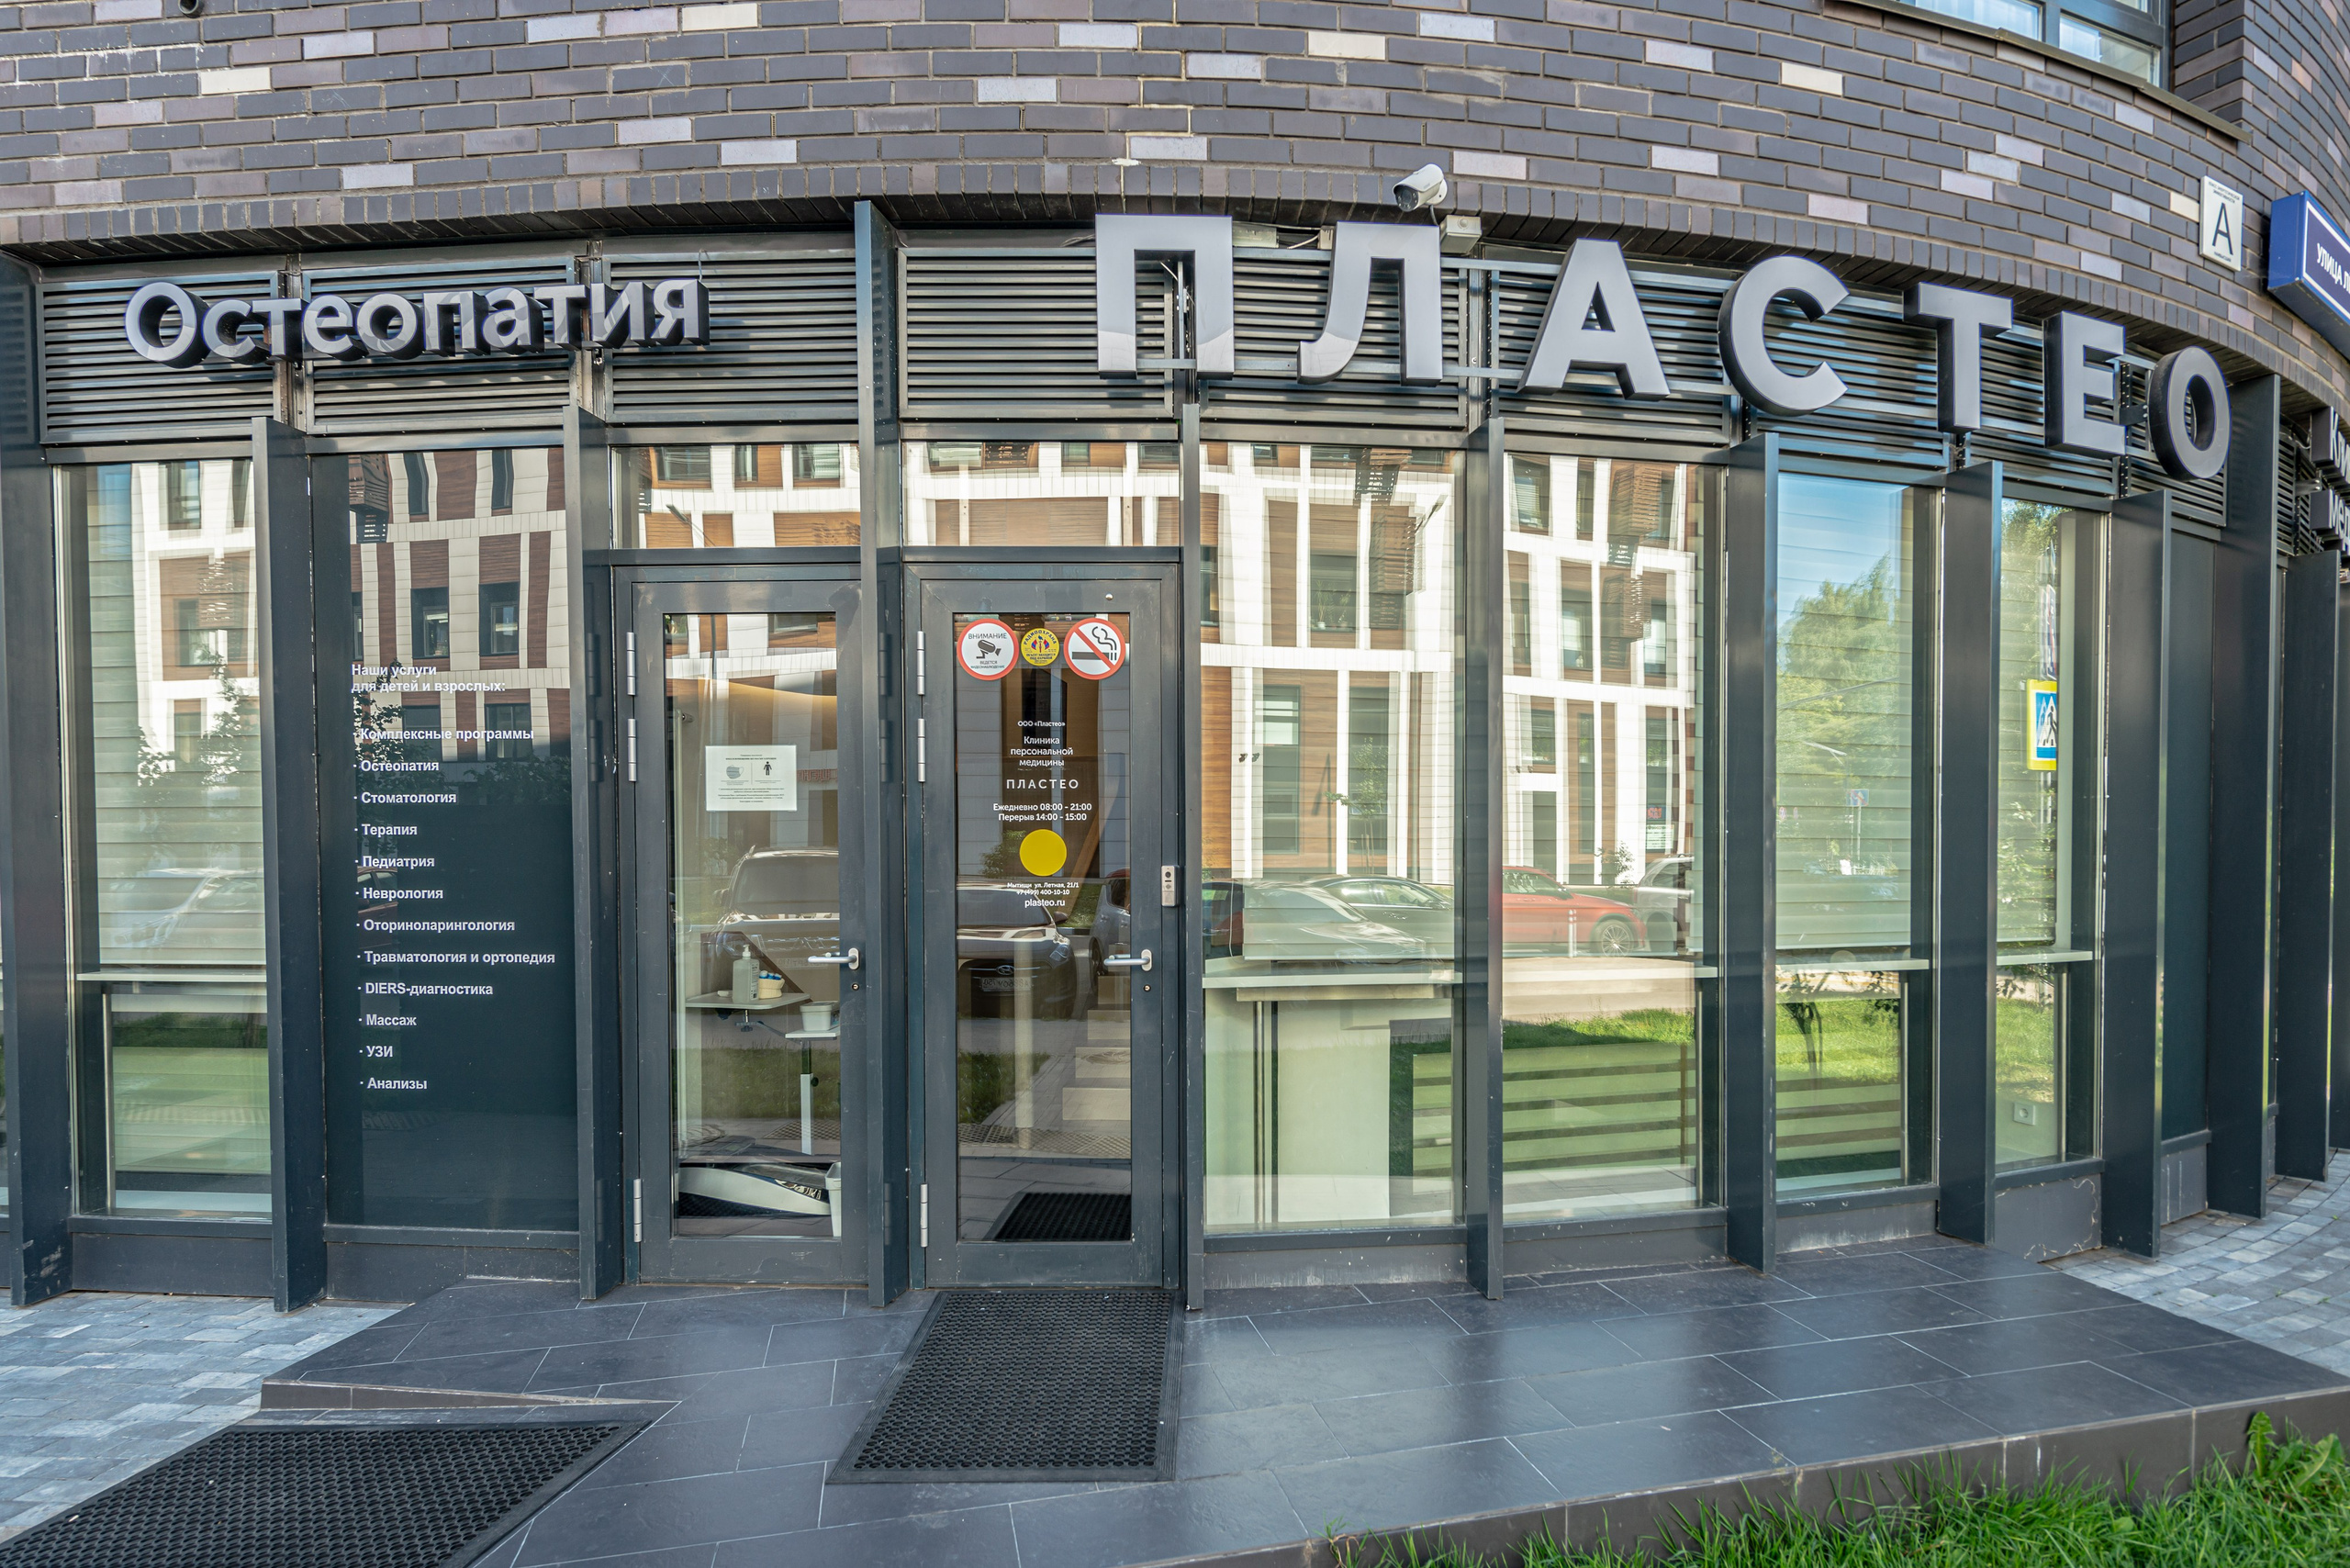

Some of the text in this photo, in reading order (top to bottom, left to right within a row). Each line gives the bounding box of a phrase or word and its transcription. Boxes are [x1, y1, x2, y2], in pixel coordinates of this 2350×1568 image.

[2316, 242, 2343, 286] УЛИЦА
[124, 278, 711, 368] Остеопатия
[1095, 214, 2232, 481] ПЛАСТЕО
[351, 664, 437, 678] Наши услуги
[351, 680, 505, 694] для детей и взрослых:
[360, 728, 534, 742] Комплексные программы
[1024, 736, 1060, 745] Клиника
[1010, 747, 1074, 756] персональной
[361, 760, 440, 772] Остеопатия
[1019, 759, 1065, 767] медицины
[1006, 778, 1079, 790] ПЛАСТЕО
[361, 791, 456, 804] Стоматология
[992, 803, 1038, 812] Ежедневно
[998, 813, 1035, 822] Перерыв
[362, 823, 418, 837] Терапия
[363, 856, 435, 869] Педиатрия
[363, 887, 443, 902] Неврология
[1024, 899, 1065, 908] plasteo.ru
[364, 919, 515, 934] Оториноларингология
[364, 950, 555, 965] Травматология и ортопедия
[365, 982, 493, 996] DIERS-диагностика
[366, 1014, 417, 1026] Массаж
[366, 1046, 393, 1058] УЗИ
[367, 1077, 428, 1090] Анализы
